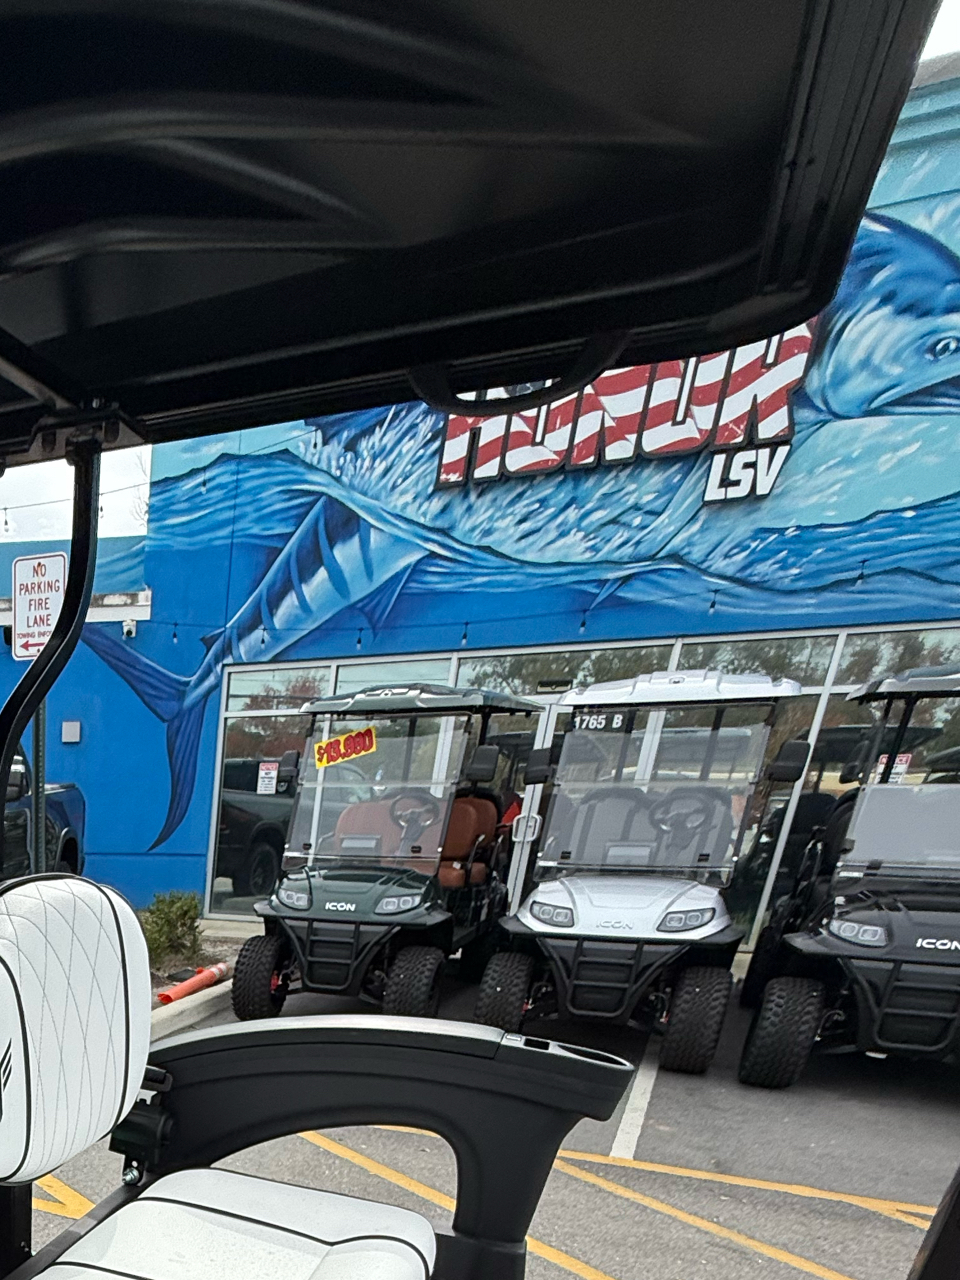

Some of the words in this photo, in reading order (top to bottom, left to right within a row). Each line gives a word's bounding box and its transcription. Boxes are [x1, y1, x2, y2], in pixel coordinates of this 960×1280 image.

[704, 445, 791, 501] LSV
[33, 564, 47, 578] NO
[19, 580, 60, 596] PARKING
[28, 598, 50, 611] FIRE
[26, 614, 52, 628] LANE
[574, 714, 606, 729] 1765
[612, 714, 623, 728] B
[325, 901, 356, 911] ICON
[596, 920, 635, 930] ICON
